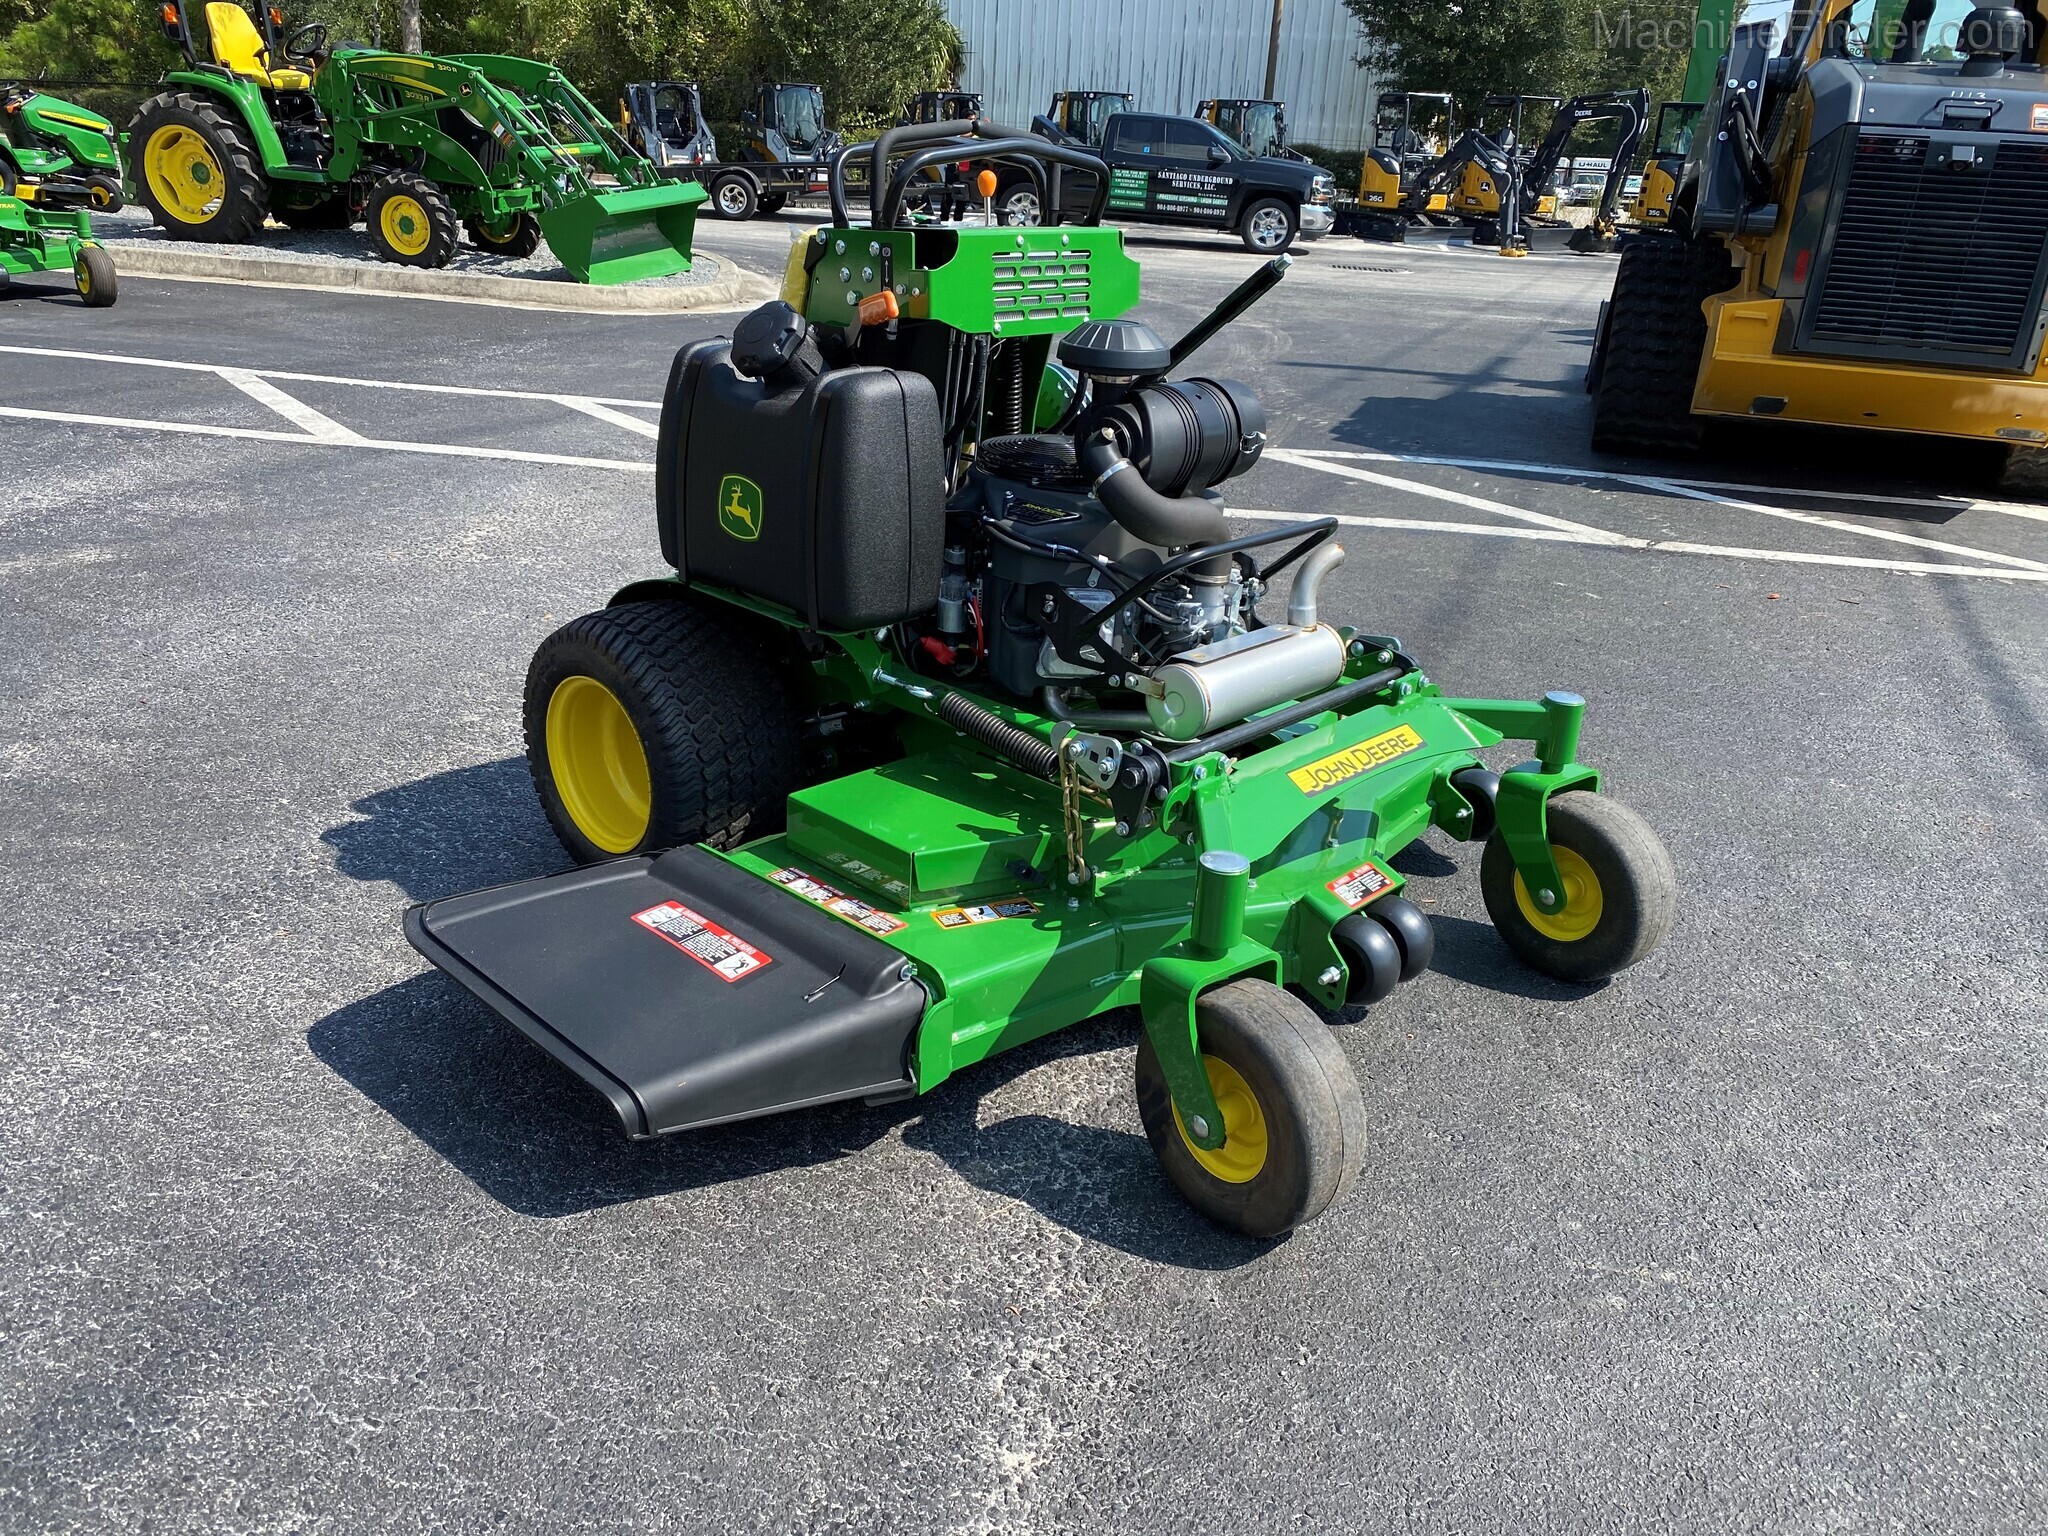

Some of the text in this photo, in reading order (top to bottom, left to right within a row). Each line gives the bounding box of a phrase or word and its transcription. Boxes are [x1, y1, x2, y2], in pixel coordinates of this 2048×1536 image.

[1574, 109, 1593, 117] DEERE
[1157, 171, 1233, 185] SANTIAGO UNDERGROUND
[1171, 180, 1203, 190] SERVICES,
[1368, 194, 1383, 203] 26G
[1305, 733, 1414, 788] JOHN DEERE
[729, 936, 758, 955] PELIGRO
